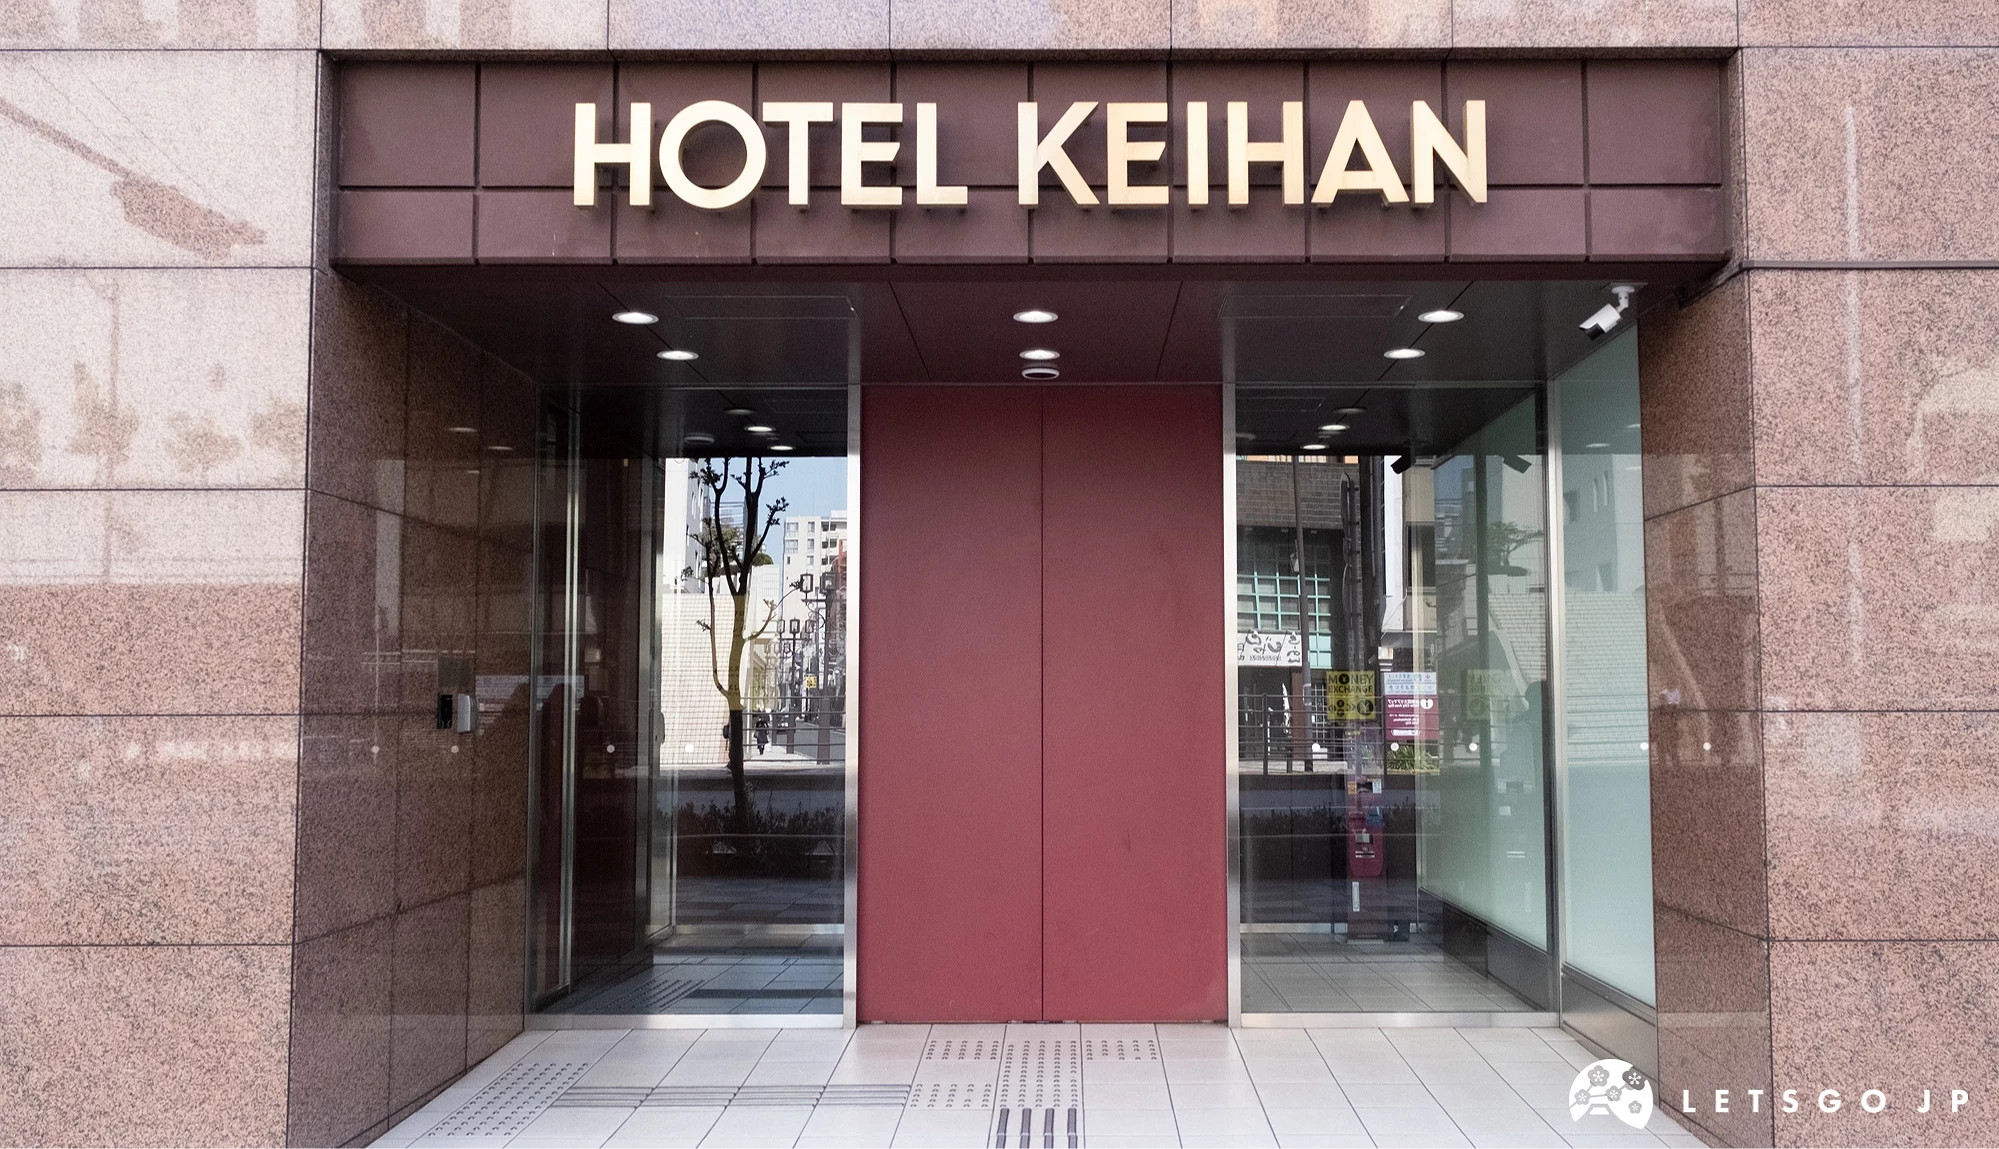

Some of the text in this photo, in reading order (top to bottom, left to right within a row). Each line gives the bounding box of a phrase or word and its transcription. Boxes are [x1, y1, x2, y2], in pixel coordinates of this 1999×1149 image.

[574, 100, 1488, 209] HOTEL KEIHAN
[1328, 686, 1373, 694] EXCHANGE
